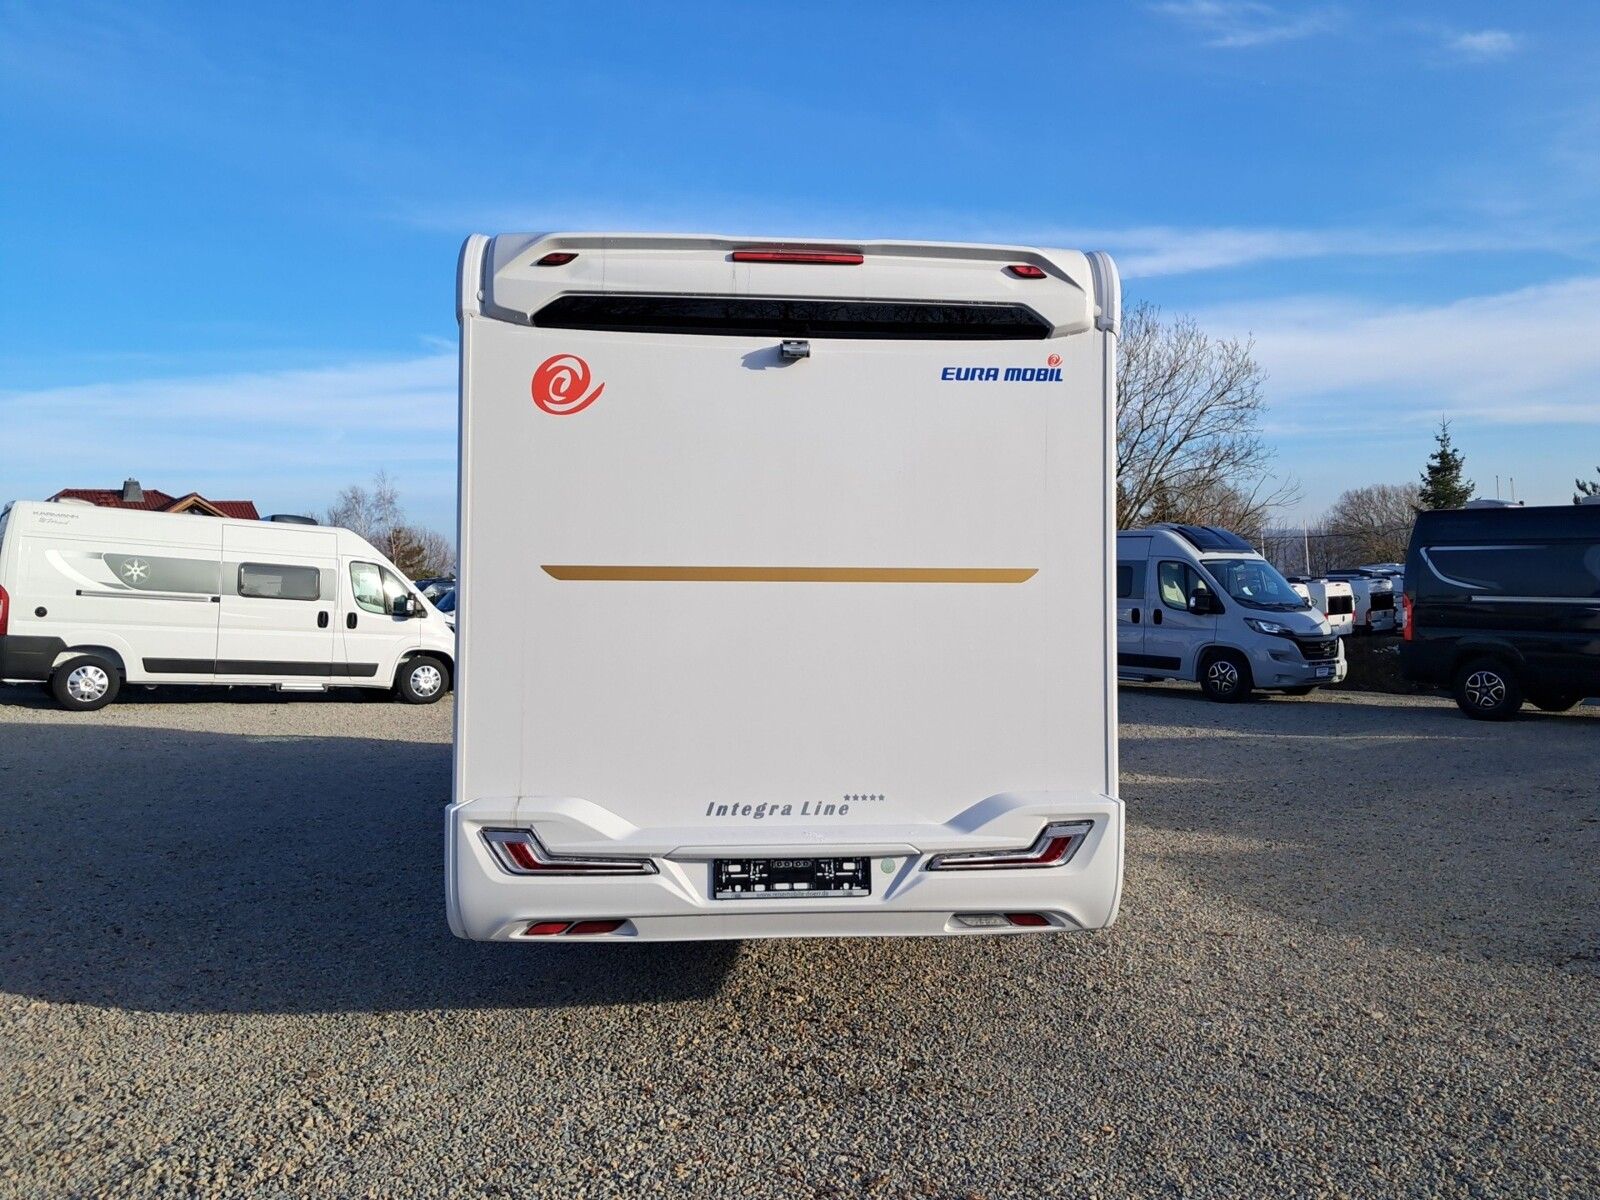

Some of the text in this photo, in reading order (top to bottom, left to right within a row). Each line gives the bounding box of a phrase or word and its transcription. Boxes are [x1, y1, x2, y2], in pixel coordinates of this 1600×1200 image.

[941, 367, 1063, 382] EURA MOBIL
[706, 801, 849, 819] Integra Line
